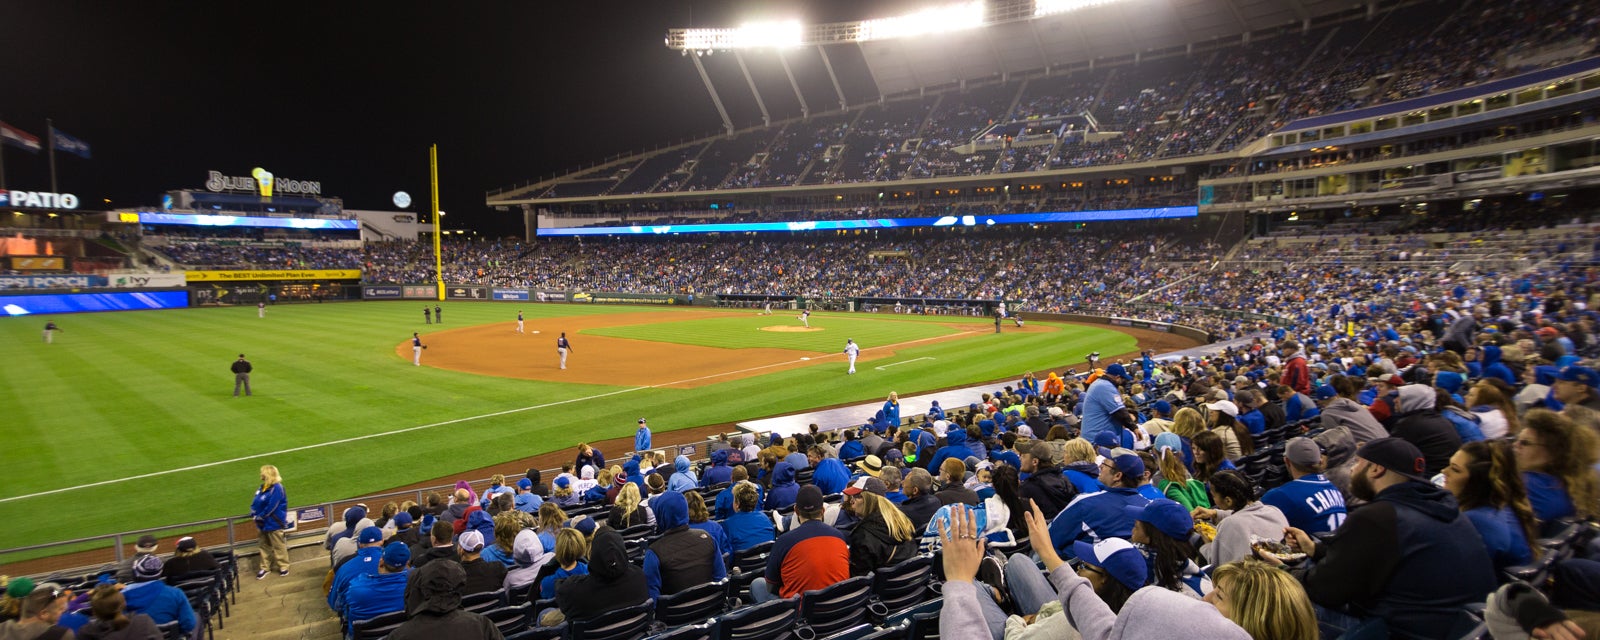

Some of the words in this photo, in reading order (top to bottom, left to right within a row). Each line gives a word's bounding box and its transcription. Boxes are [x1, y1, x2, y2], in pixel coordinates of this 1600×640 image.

[206, 170, 256, 192] BLUE
[275, 177, 322, 194] MOON
[10, 190, 79, 209] PATIO
